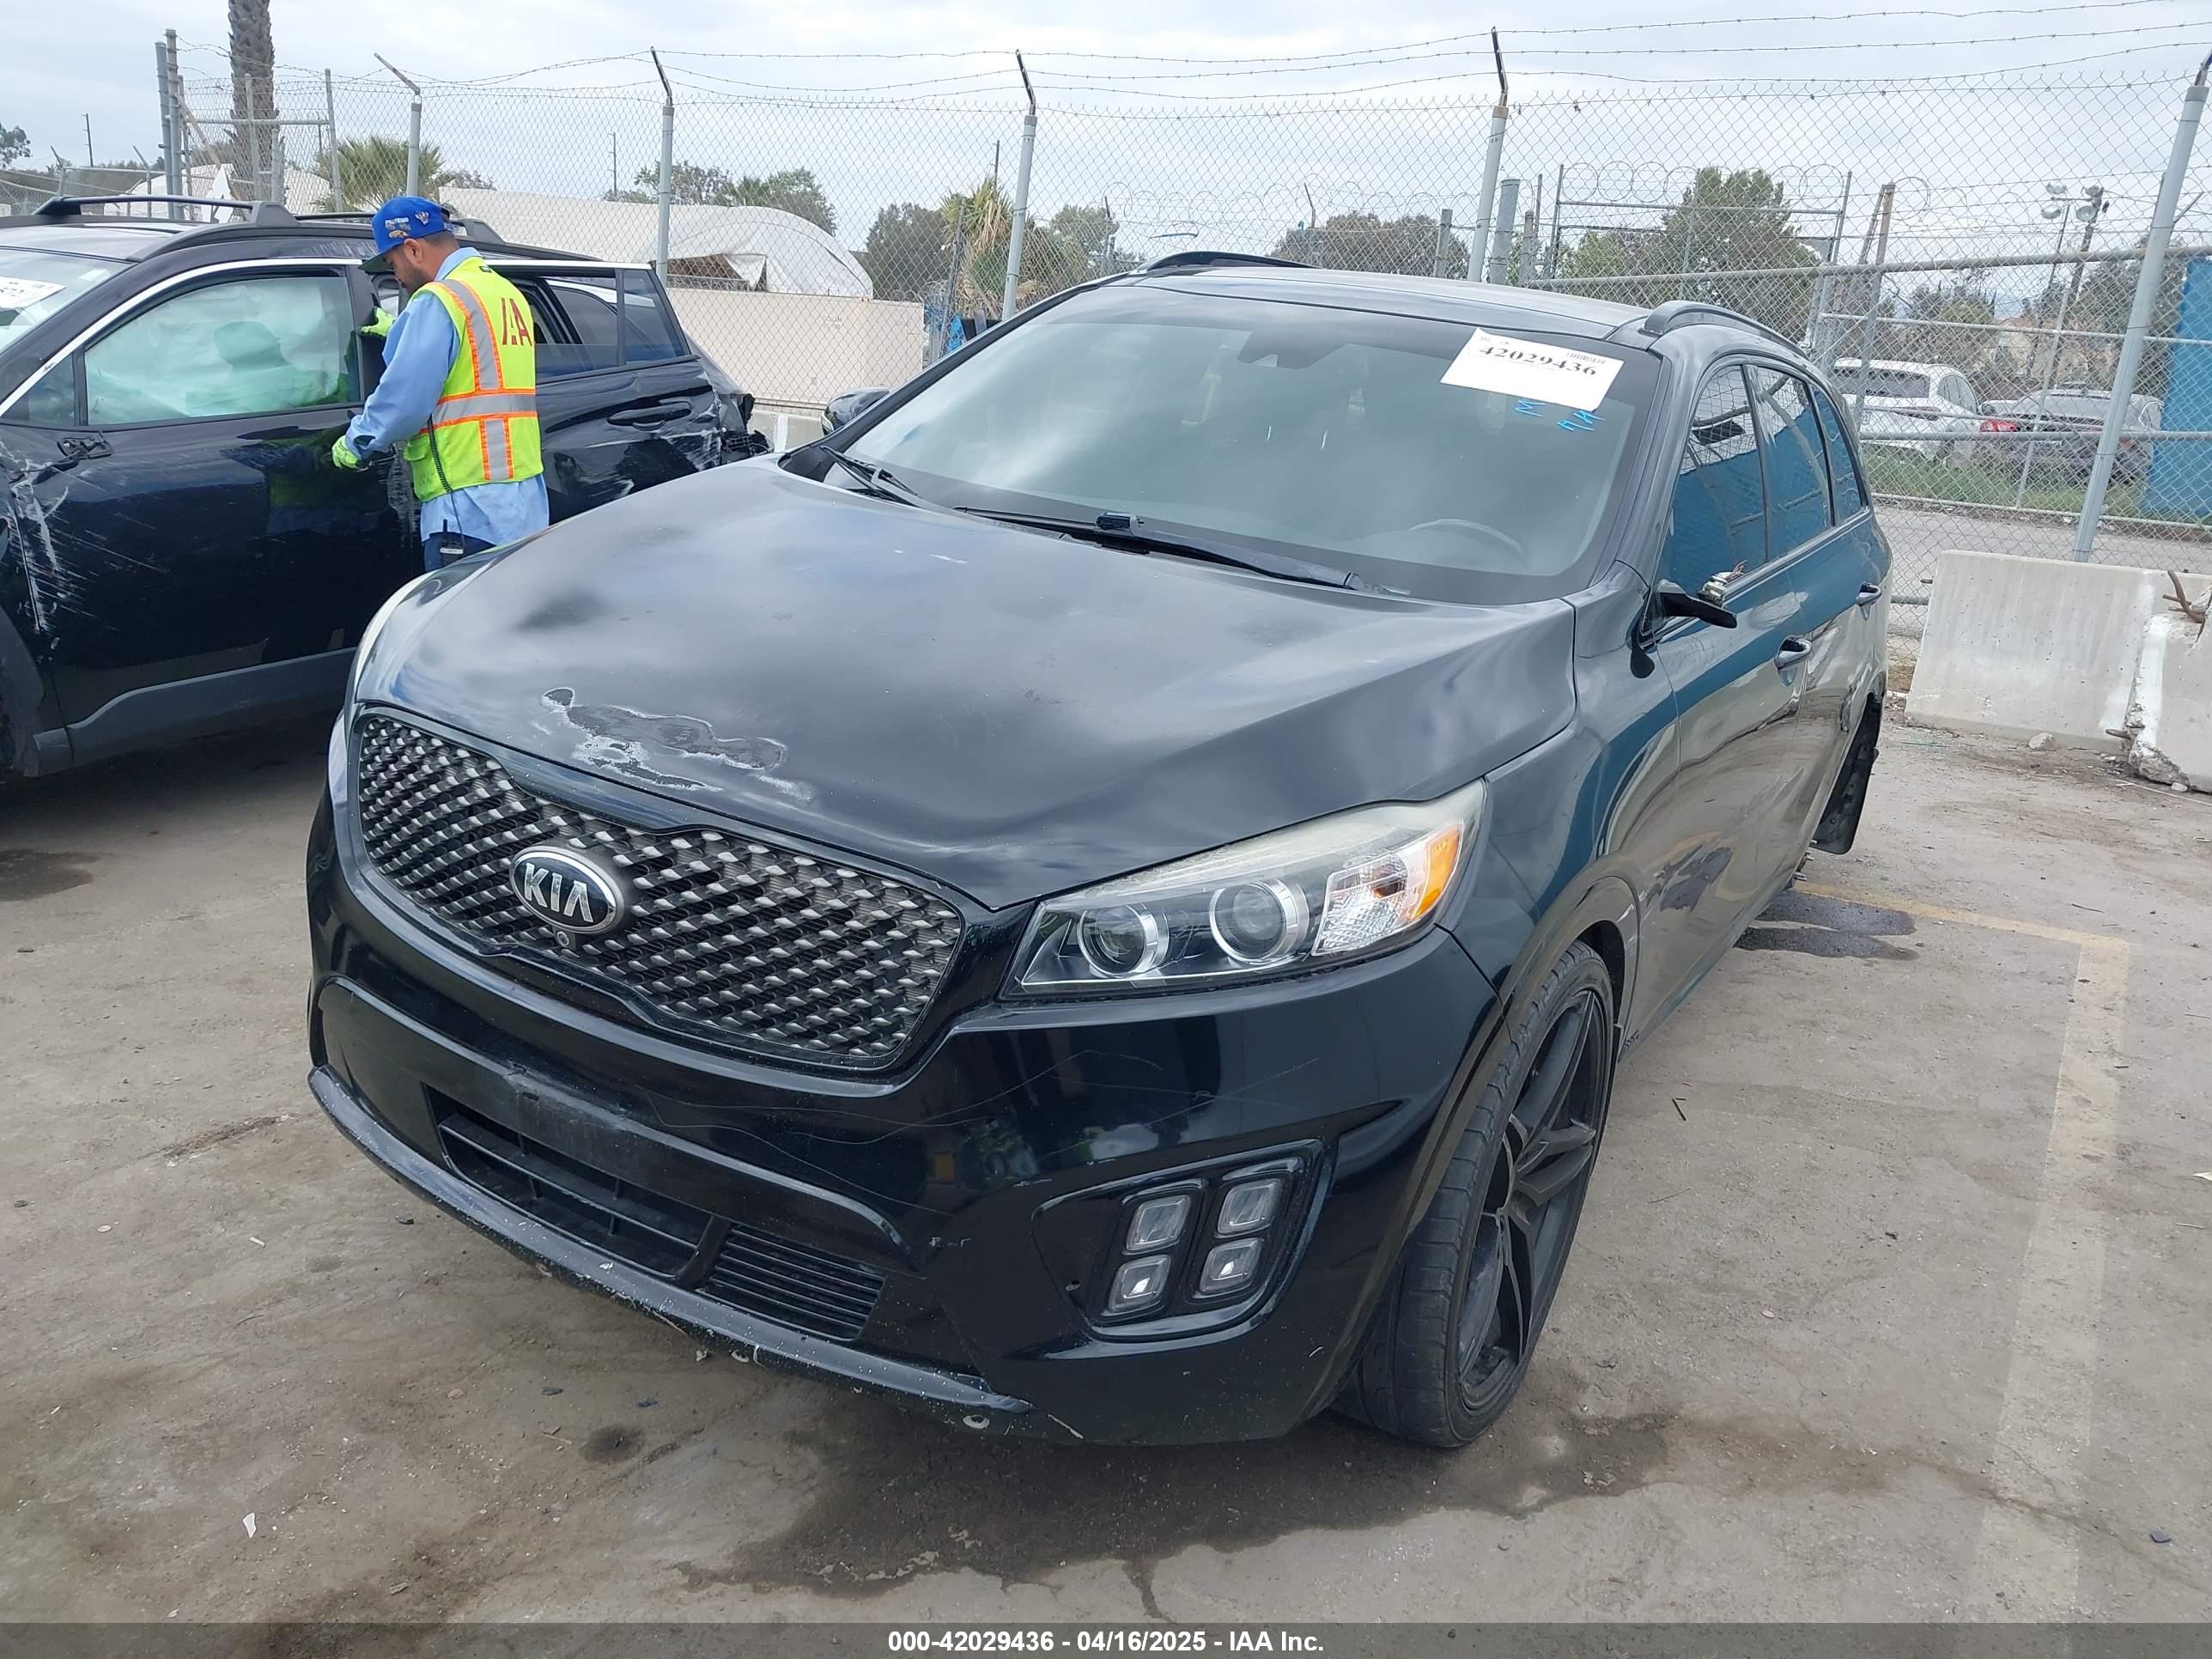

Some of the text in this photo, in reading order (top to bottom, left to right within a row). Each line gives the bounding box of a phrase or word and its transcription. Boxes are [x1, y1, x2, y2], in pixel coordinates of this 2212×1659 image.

[501, 297, 533, 347] IAA
[1478, 345, 1597, 376] 42029436
[524, 862, 594, 923] KIA
